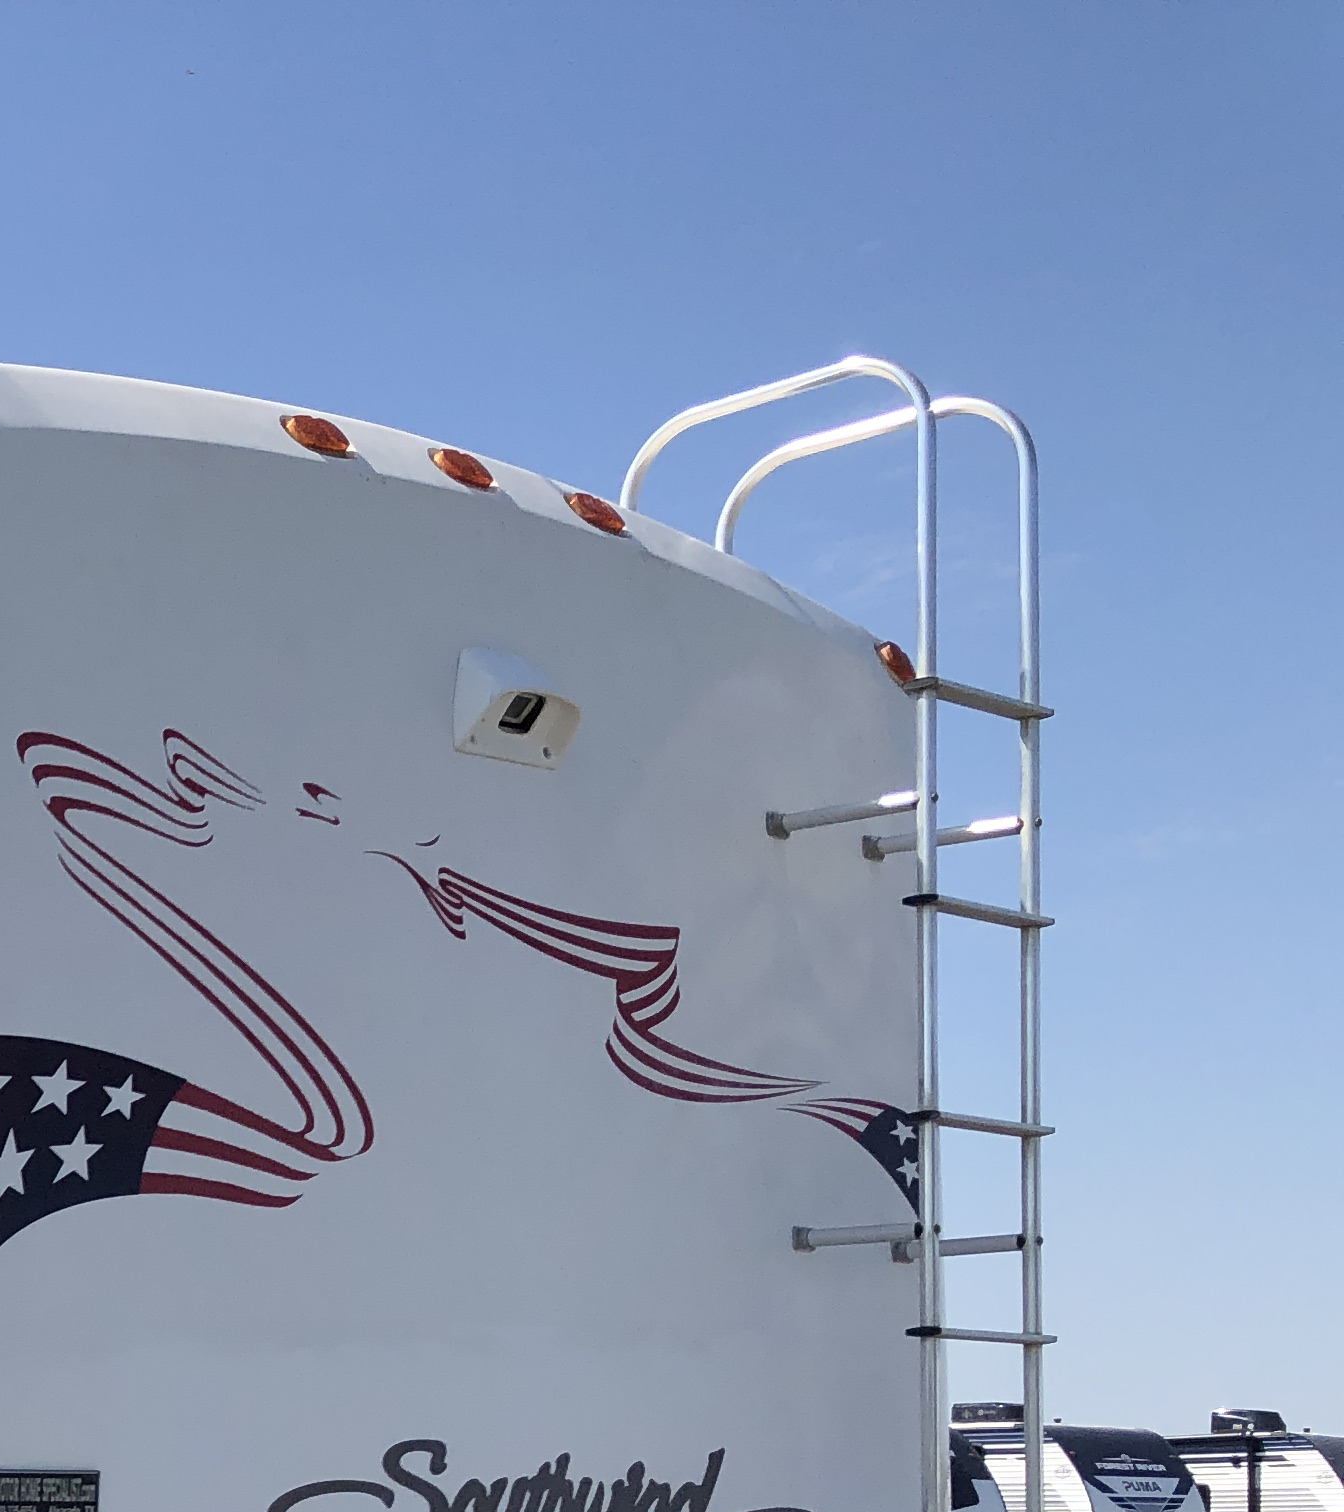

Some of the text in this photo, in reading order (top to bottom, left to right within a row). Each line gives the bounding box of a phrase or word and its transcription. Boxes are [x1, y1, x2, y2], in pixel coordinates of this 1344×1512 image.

[1095, 1462, 1166, 1471] FOREST RIVER
[1121, 1480, 1162, 1492] PUMA
